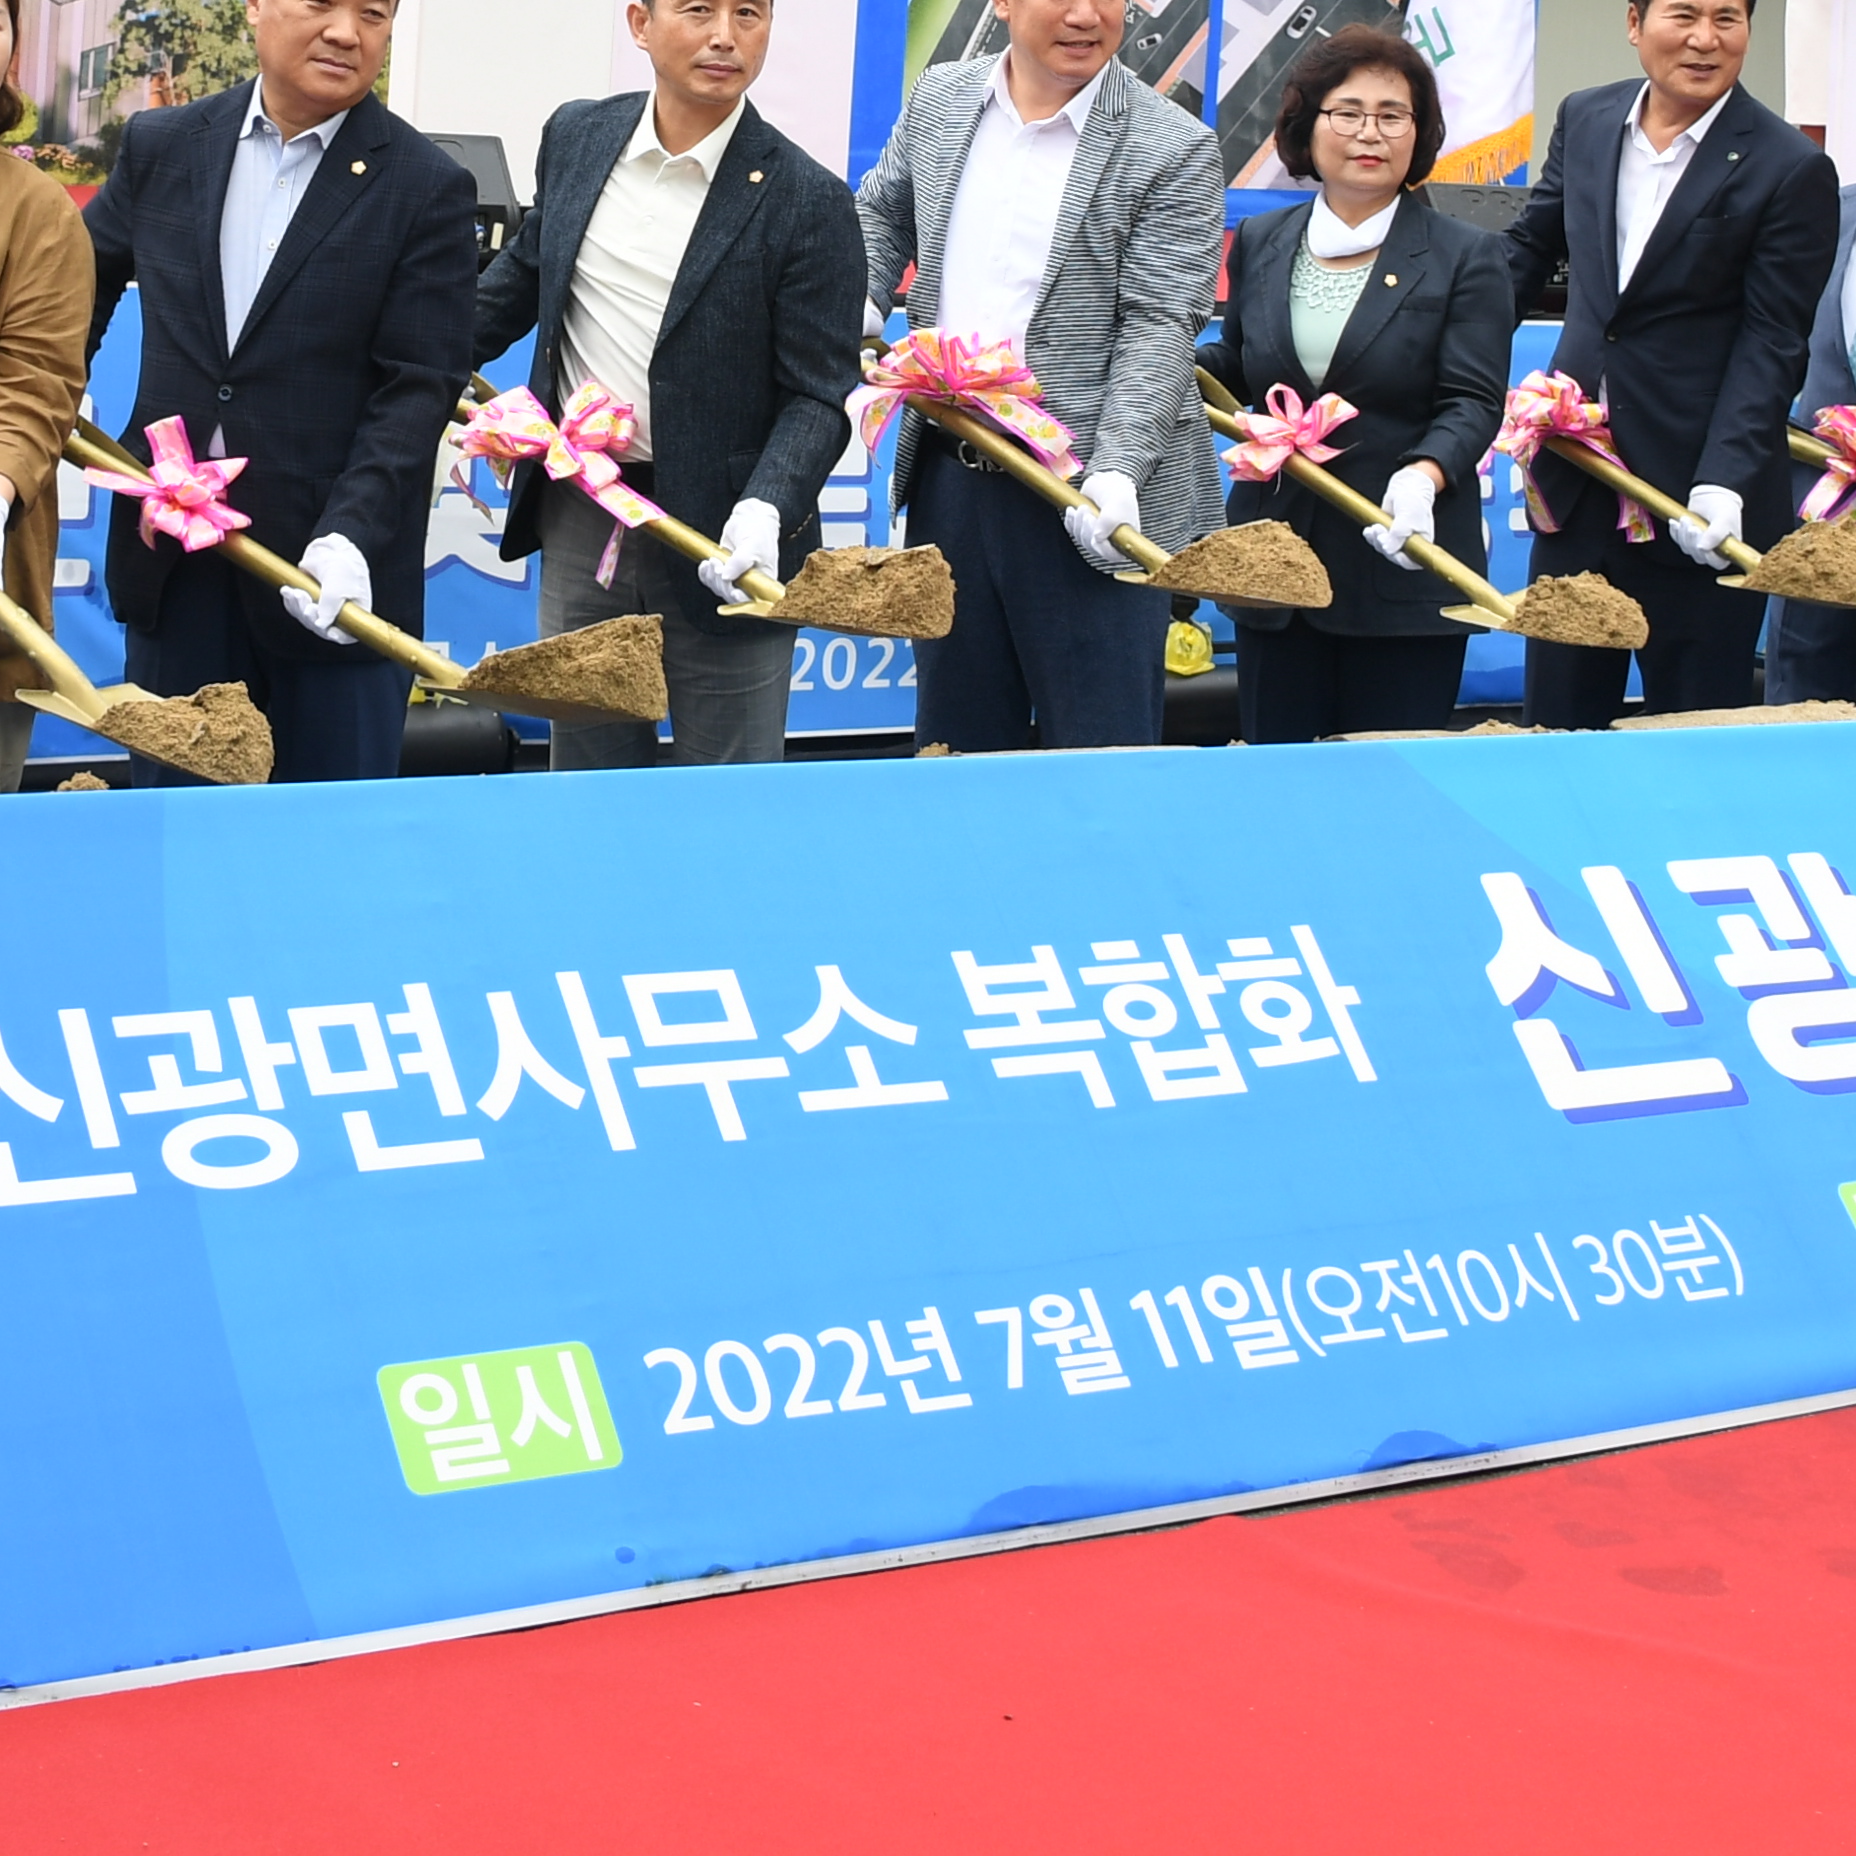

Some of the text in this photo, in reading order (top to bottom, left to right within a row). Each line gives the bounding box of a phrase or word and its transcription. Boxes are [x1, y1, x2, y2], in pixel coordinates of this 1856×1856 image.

[950, 924, 1379, 1108] 복합화
[399, 1350, 603, 1482] 일시
[643, 1214, 1744, 1435] 2022년 7월 11일(오전10시 30분)
